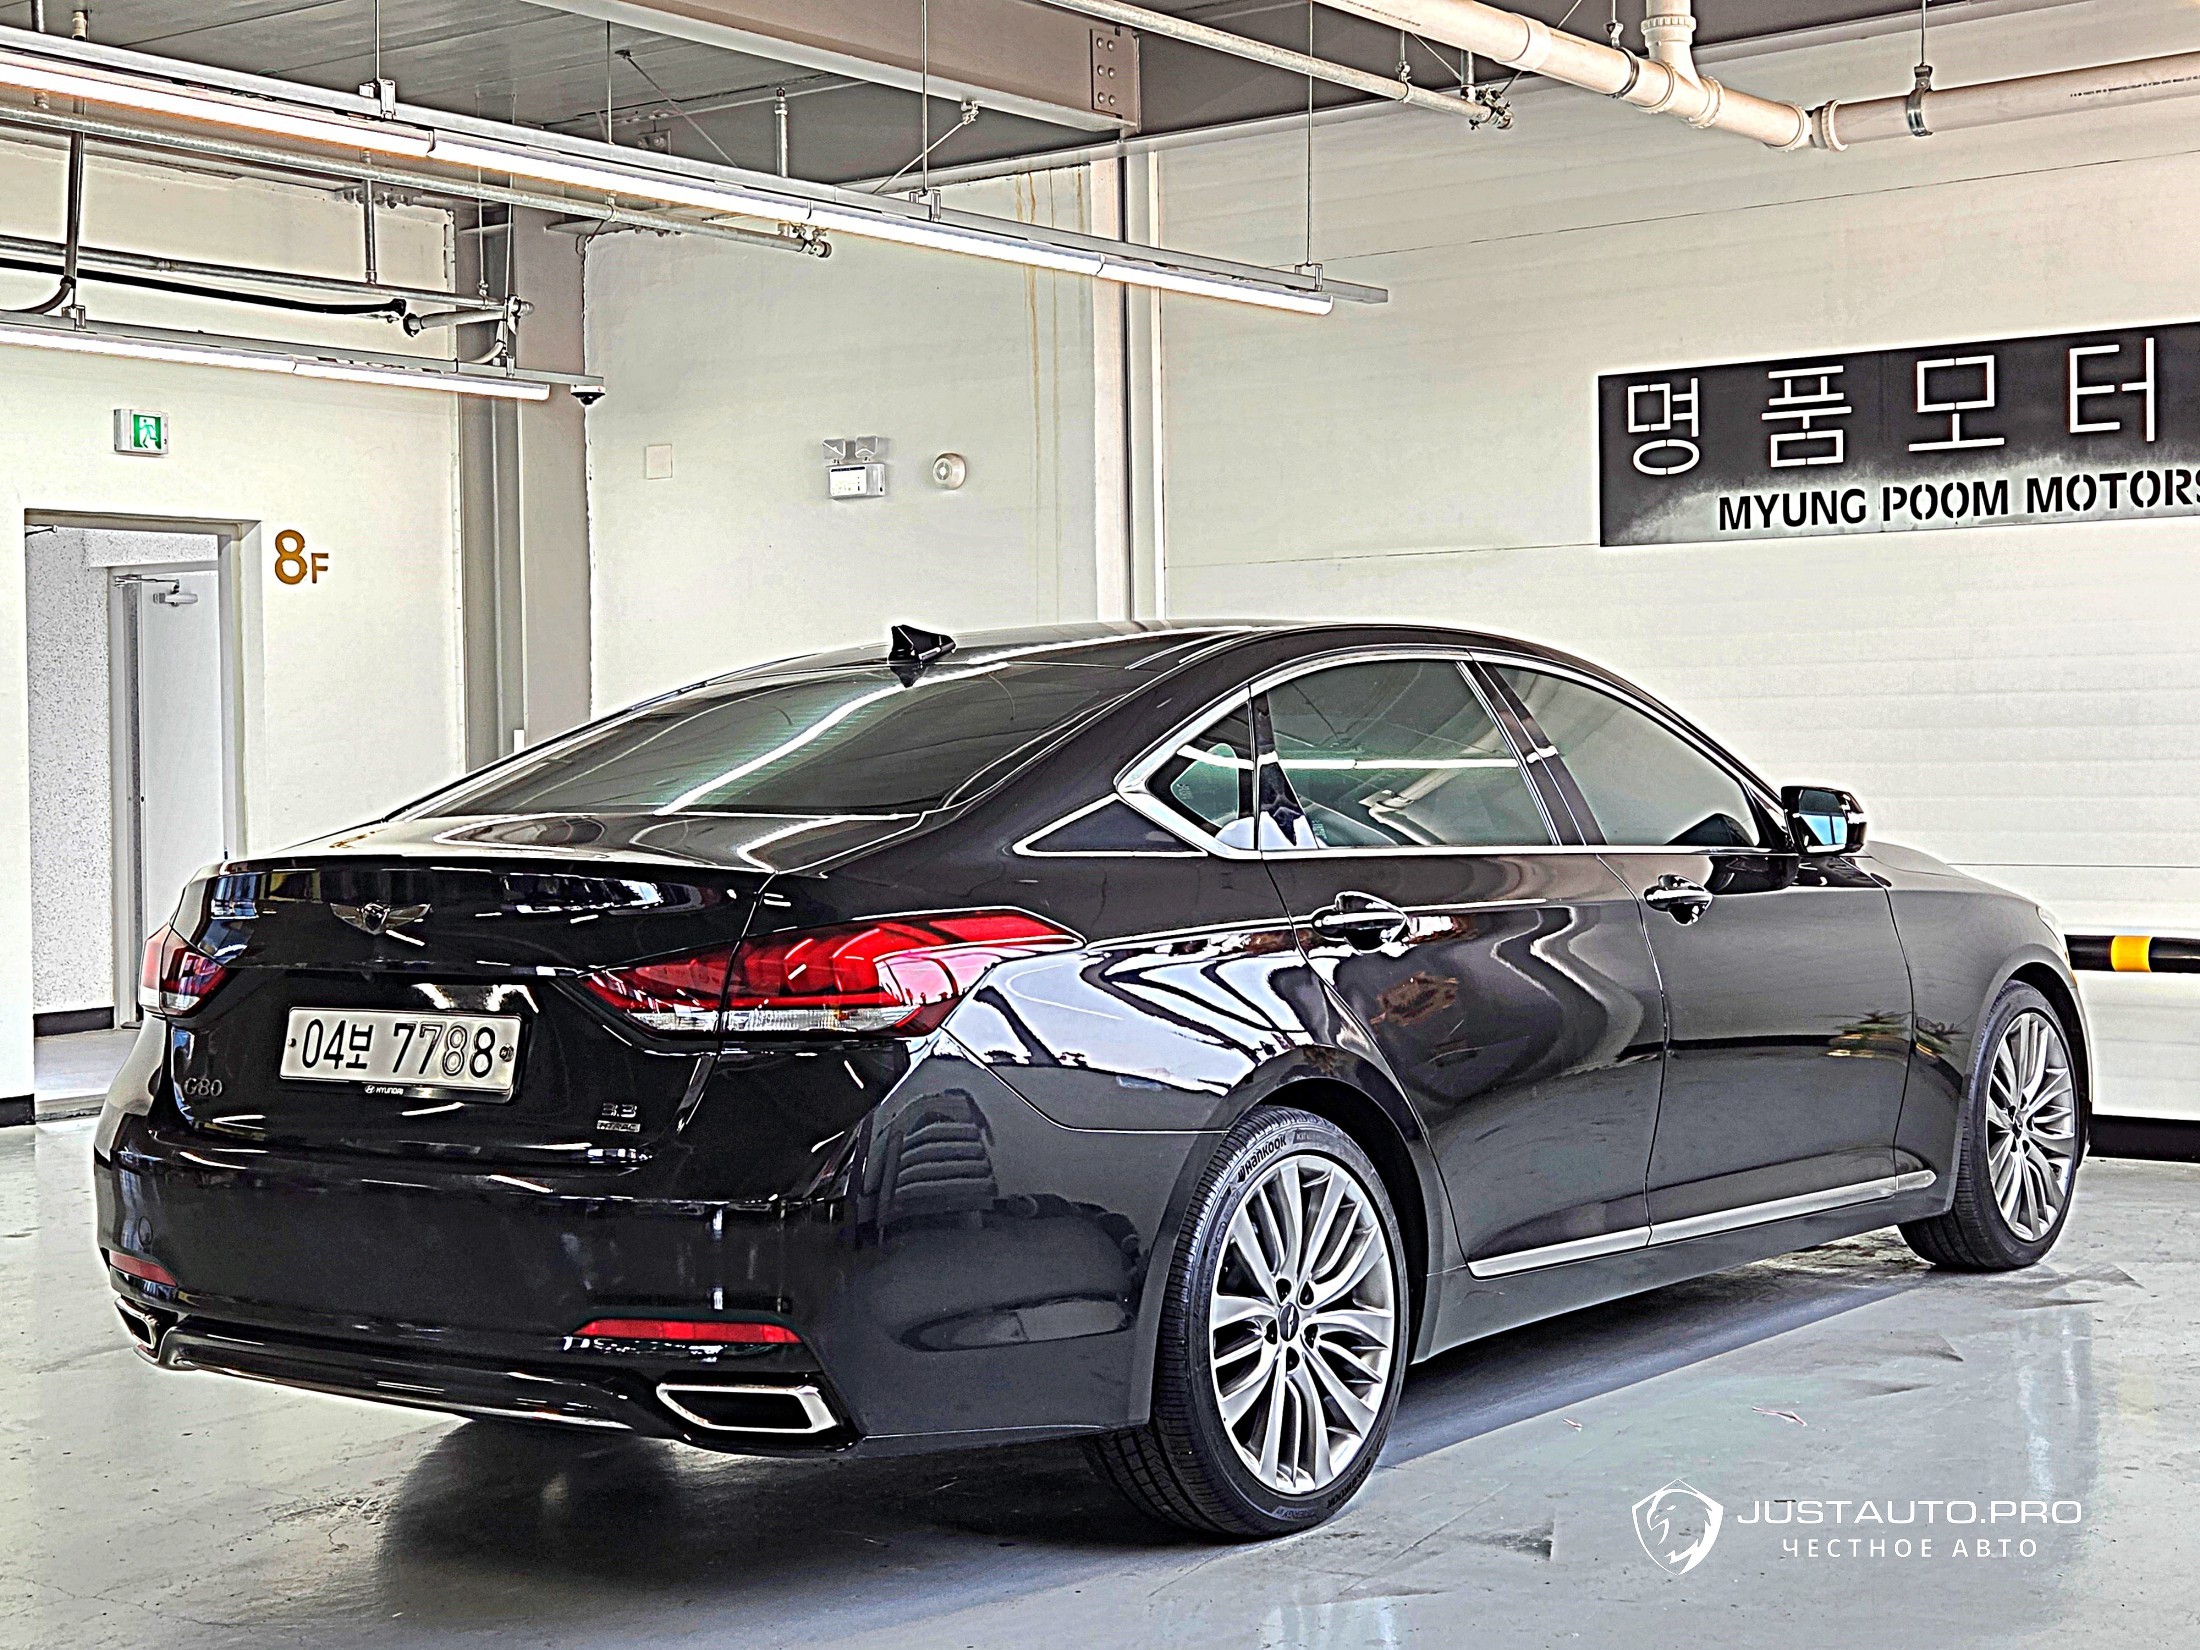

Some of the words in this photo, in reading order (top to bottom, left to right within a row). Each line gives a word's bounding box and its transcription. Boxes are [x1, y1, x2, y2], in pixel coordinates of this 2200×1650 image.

[1718, 488, 1868, 532] MYUNG
[1882, 479, 2009, 522] POOM
[2026, 468, 2200, 515] MOTOR
[274, 528, 330, 585] 8F
[301, 1018, 374, 1070] 04보
[392, 1020, 497, 1079] 7788
[184, 1077, 223, 1097] G80
[375, 1086, 404, 1095] HYUNDAI
[601, 1102, 638, 1118] 3.3
